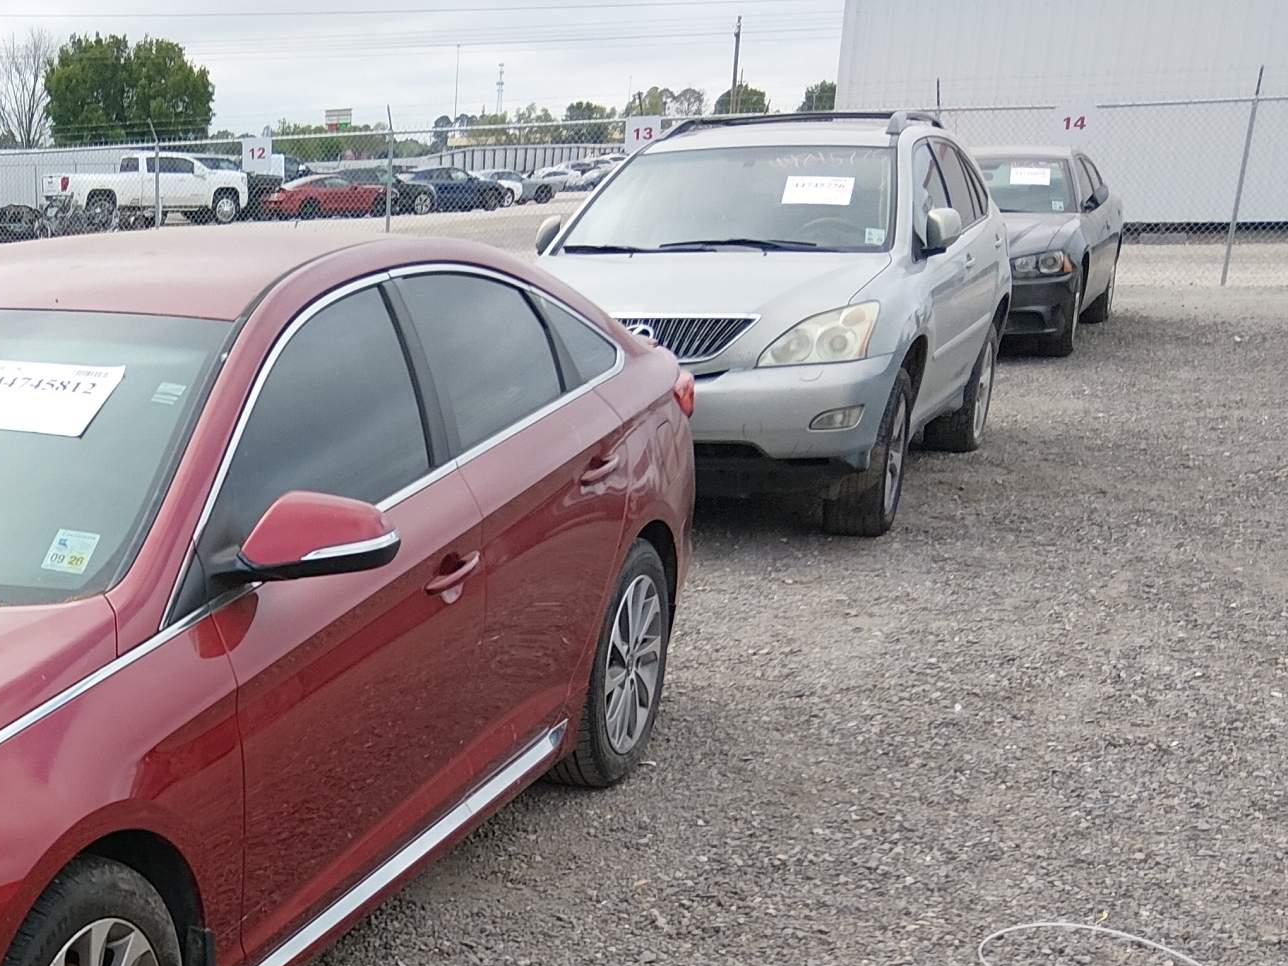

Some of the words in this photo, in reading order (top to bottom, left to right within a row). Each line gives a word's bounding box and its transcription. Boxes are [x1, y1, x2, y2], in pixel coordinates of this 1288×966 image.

[1063, 116, 1087, 130] 14
[633, 127, 653, 141] 13
[249, 147, 266, 160] 12
[50, 553, 65, 564] 09
